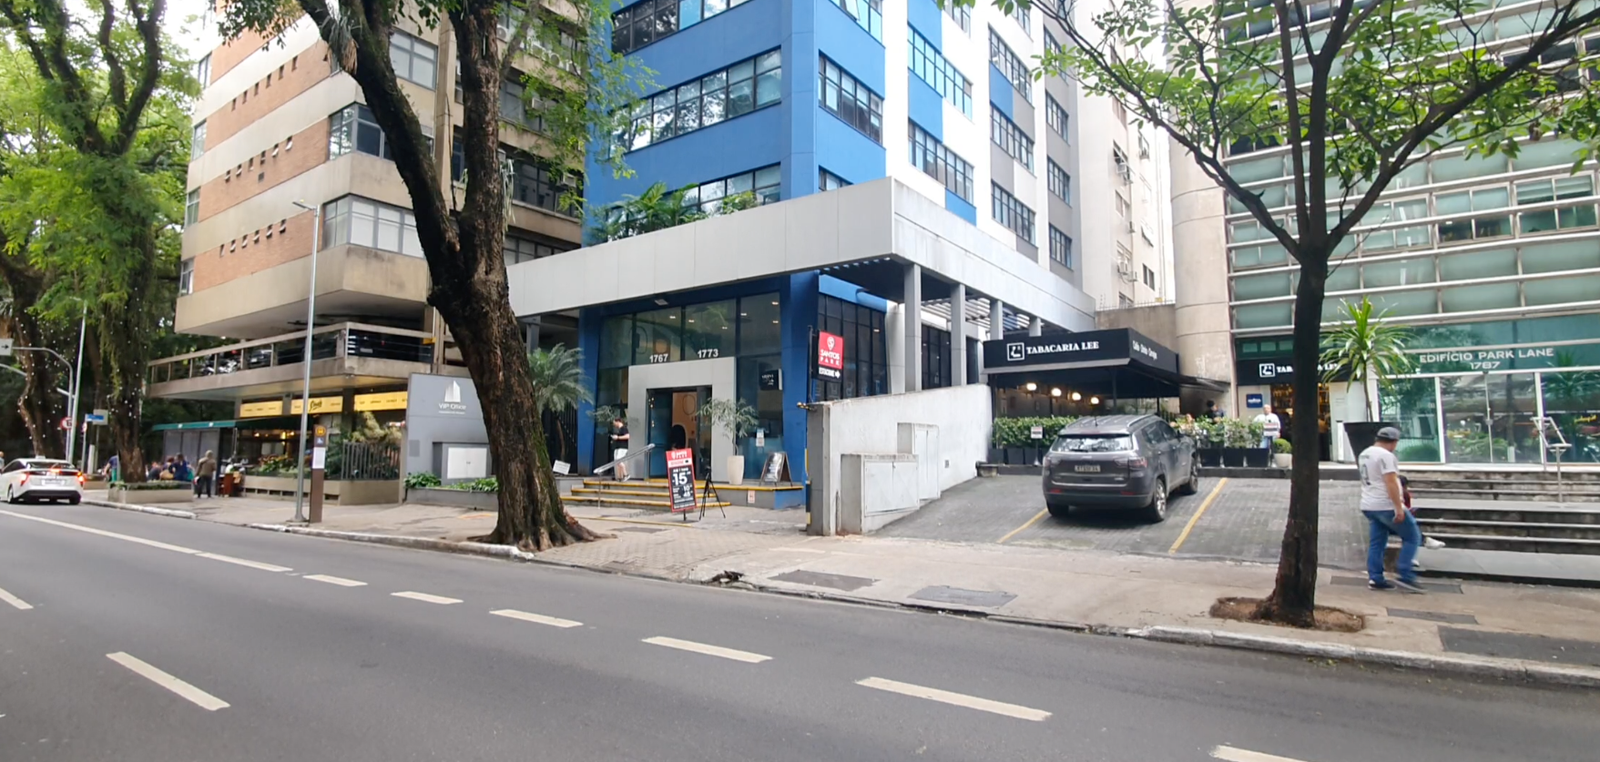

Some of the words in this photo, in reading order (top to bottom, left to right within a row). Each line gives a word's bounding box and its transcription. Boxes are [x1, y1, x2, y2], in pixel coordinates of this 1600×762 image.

[1026, 343, 1079, 354] TABACARIA
[1081, 341, 1099, 350] LEE
[649, 353, 669, 363] 1767
[697, 348, 719, 358] 1773
[820, 349, 840, 360] SANTOS
[1420, 352, 1473, 363] EDIFÍCIO
[1478, 350, 1515, 360] PARK
[1518, 348, 1554, 358] LANE
[820, 356, 840, 366] PARK
[1470, 361, 1501, 370] 1787
